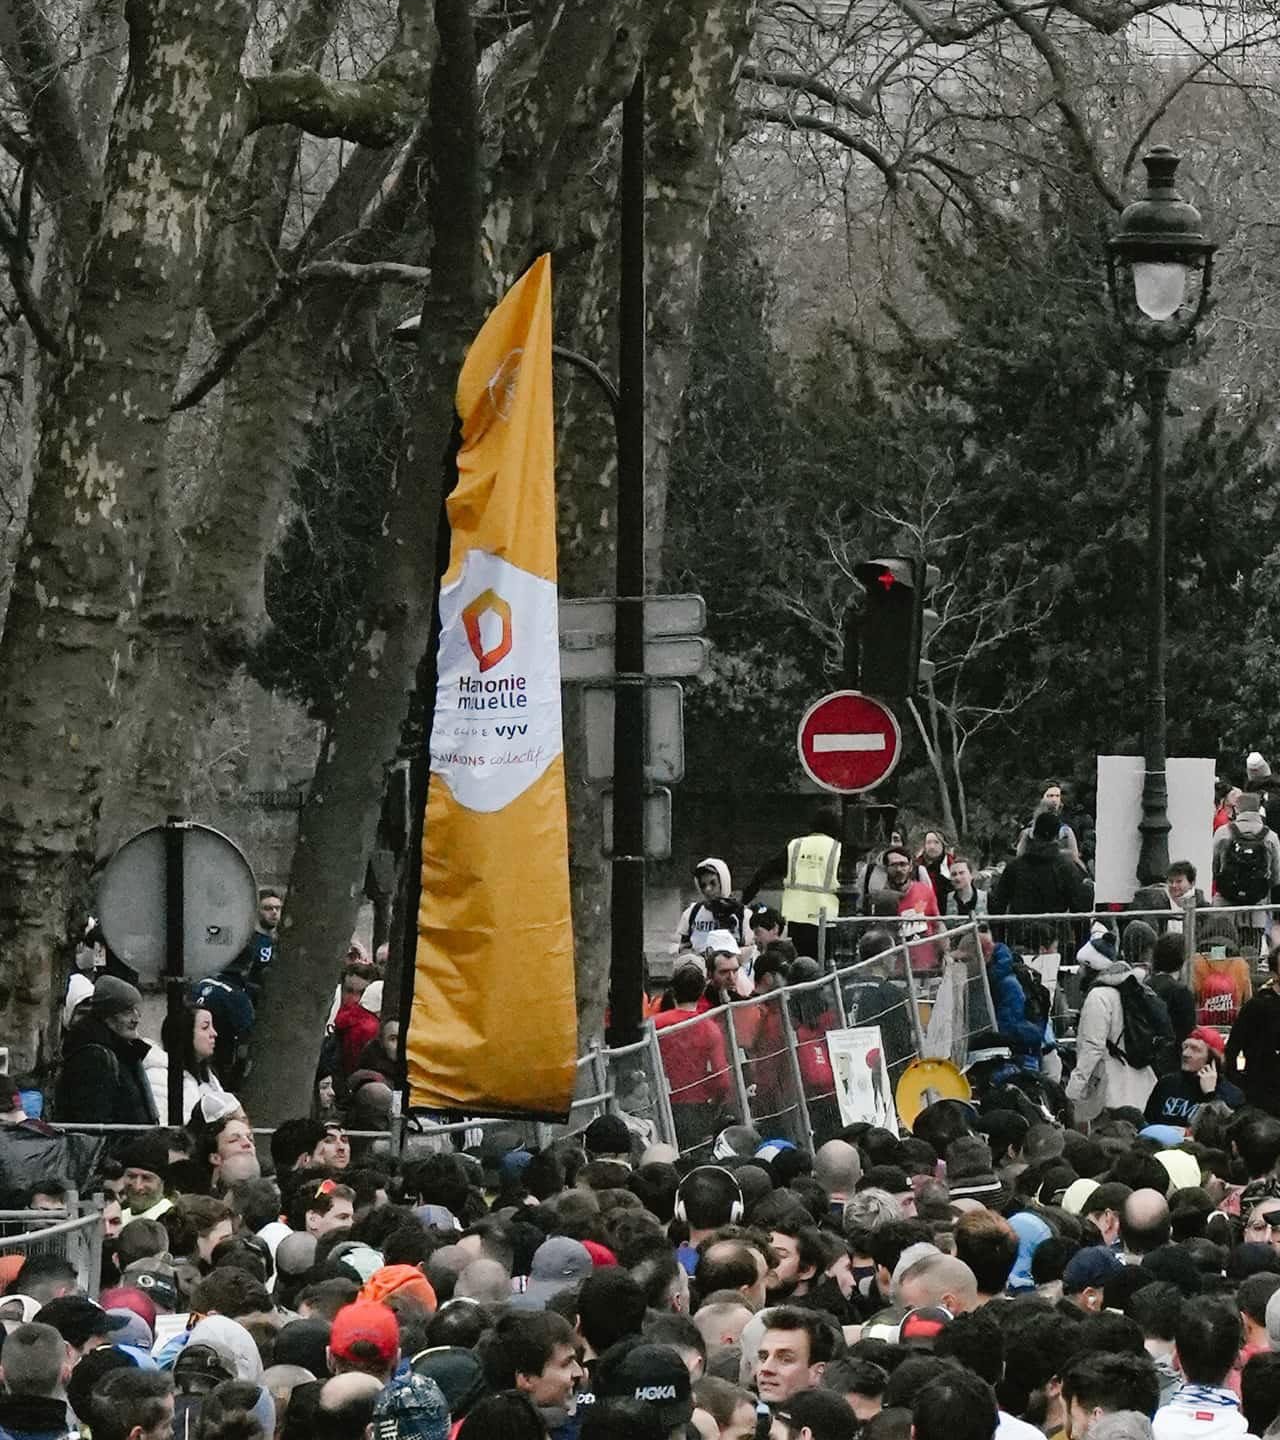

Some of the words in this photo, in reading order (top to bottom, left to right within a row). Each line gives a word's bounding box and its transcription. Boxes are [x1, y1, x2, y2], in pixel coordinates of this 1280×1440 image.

[495, 724, 528, 739] vyv
[1163, 1096, 1200, 1119] SEM
[635, 1384, 676, 1401] HOKA
